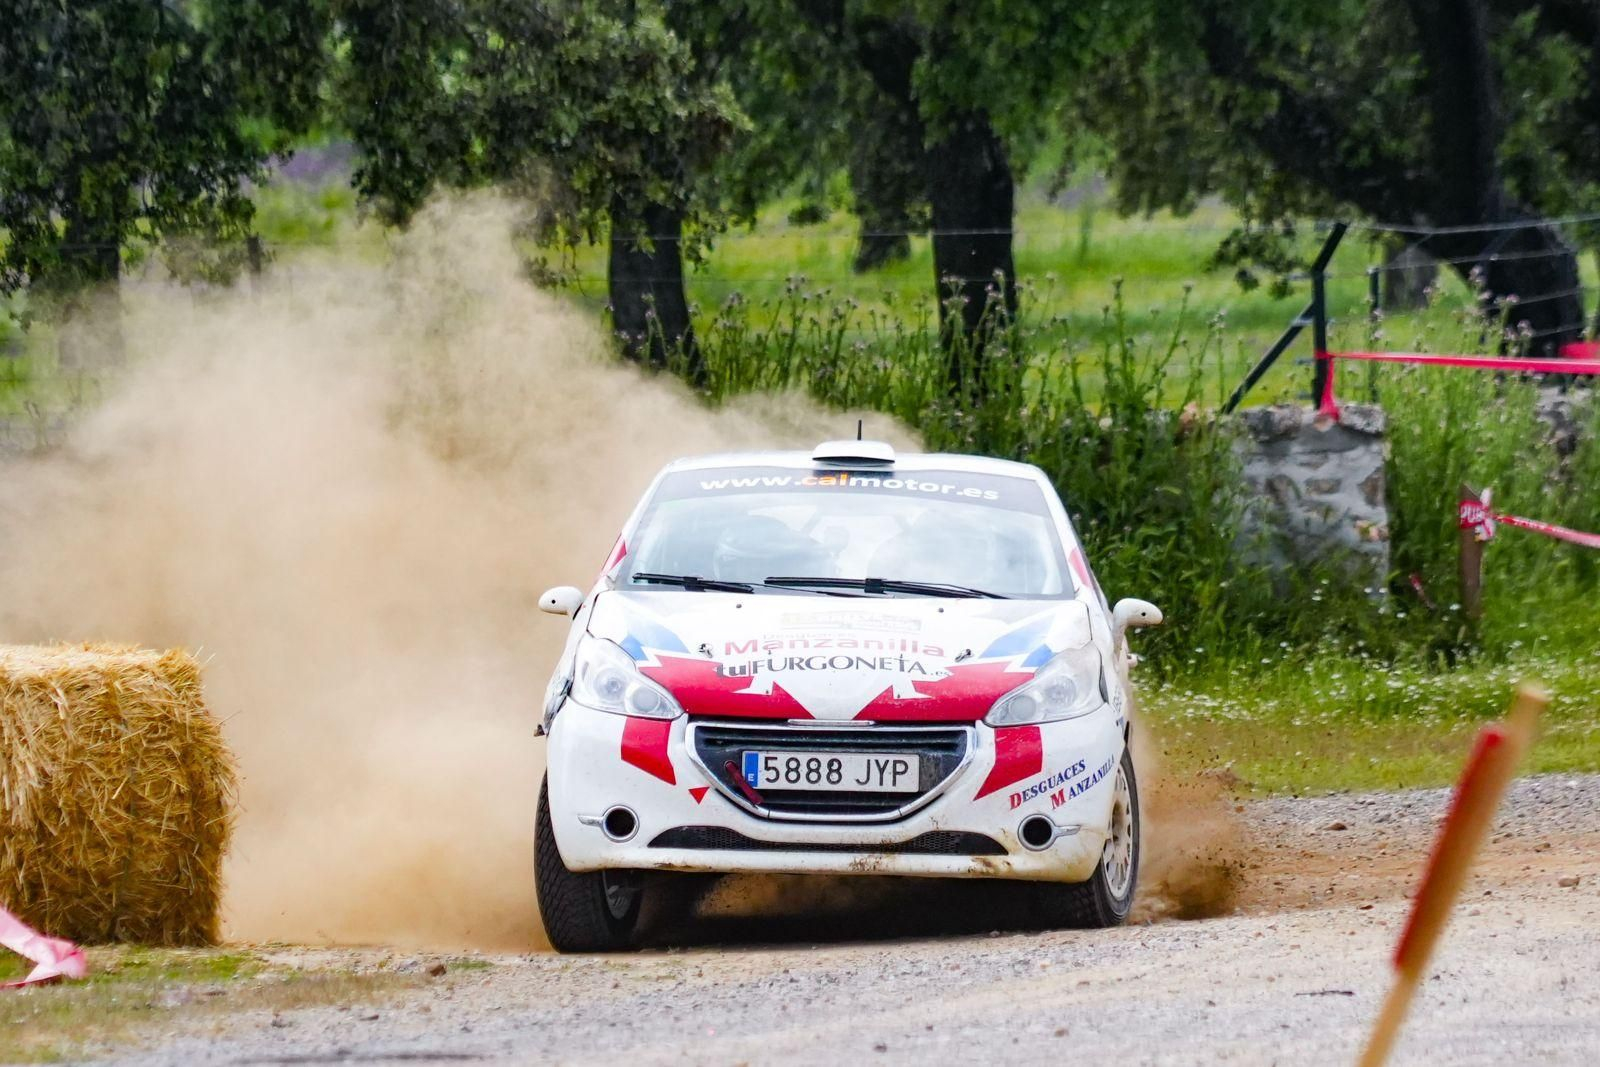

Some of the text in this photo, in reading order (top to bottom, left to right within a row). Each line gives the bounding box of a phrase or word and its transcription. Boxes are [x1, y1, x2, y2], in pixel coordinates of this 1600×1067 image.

[701, 472, 999, 500] www.calmotor.es
[724, 638, 945, 657] Manzanilla
[747, 773, 755, 782] E
[763, 756, 909, 787] 5888 JYP
[1009, 759, 1087, 810] DESGUACES
